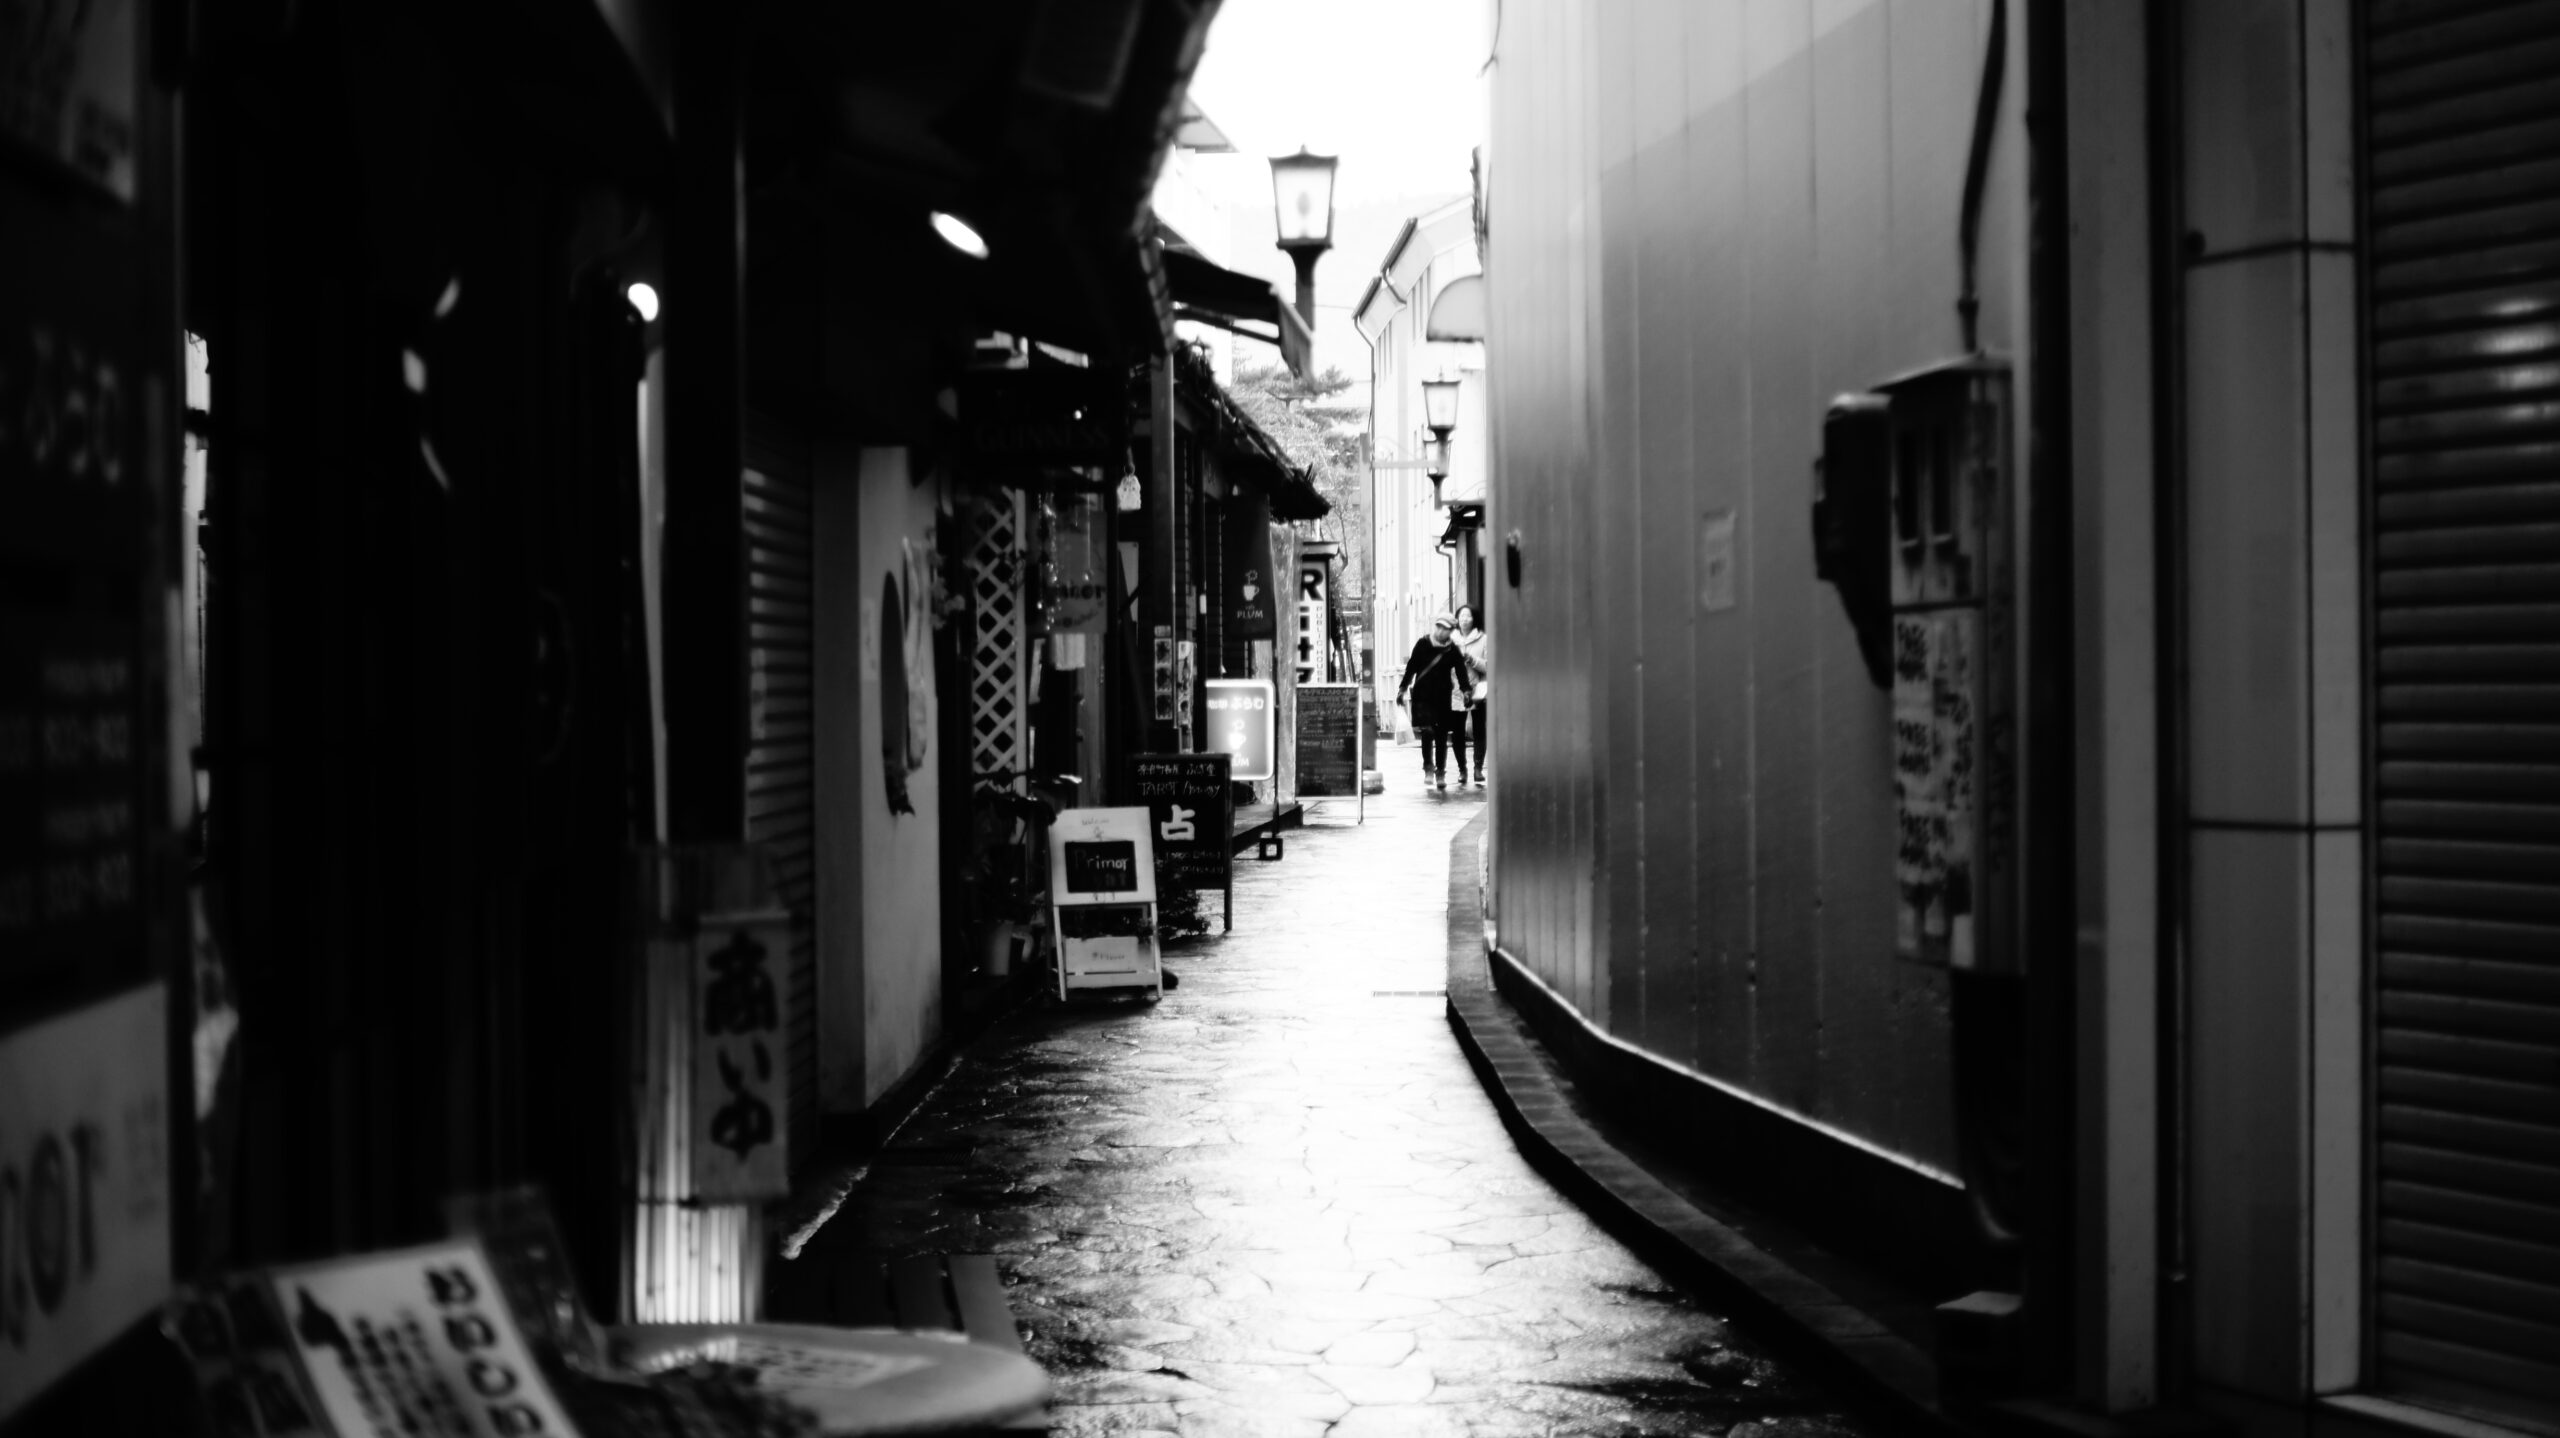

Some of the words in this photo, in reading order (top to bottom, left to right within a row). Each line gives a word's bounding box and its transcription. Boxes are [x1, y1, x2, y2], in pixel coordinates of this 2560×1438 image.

[974, 420, 1111, 453] GUINNESS
[1236, 609, 1264, 619] PLUM
[1137, 781, 1179, 797] TAROT
[1160, 803, 1197, 841] 占
[1073, 849, 1129, 872] Primor
[705, 926, 779, 1162] 商い中
